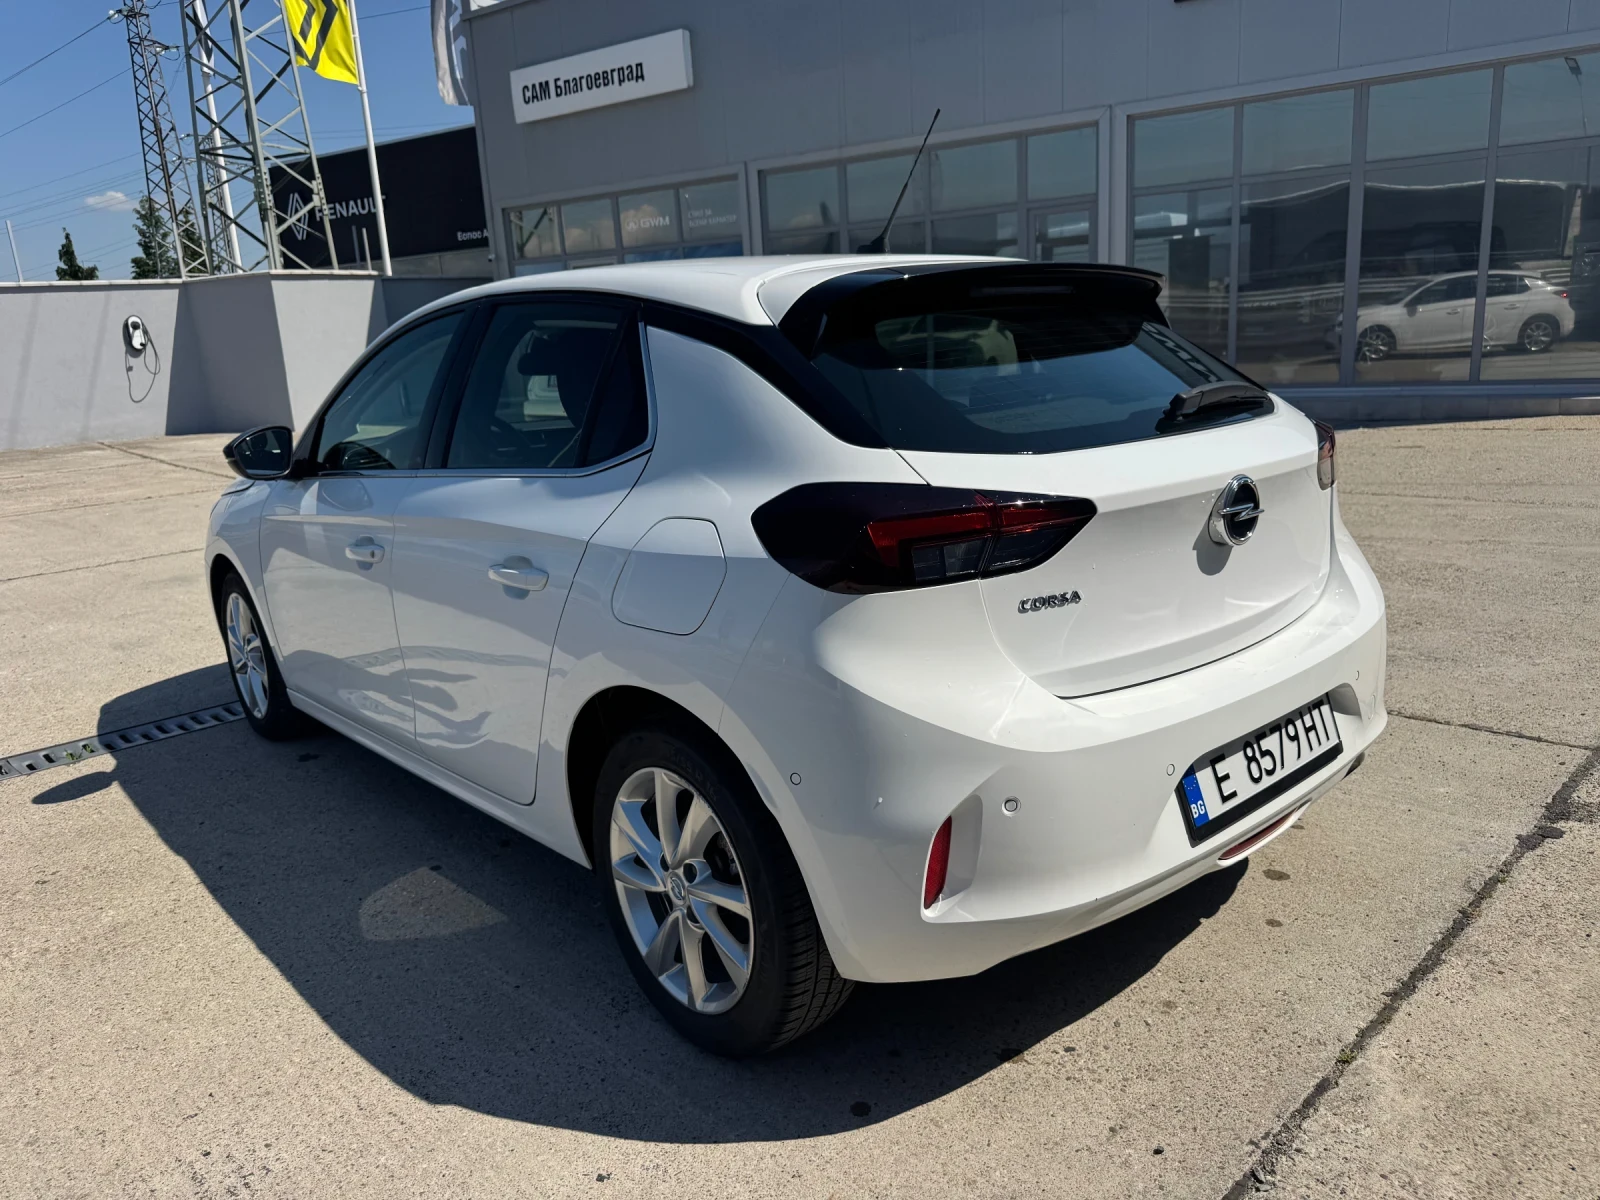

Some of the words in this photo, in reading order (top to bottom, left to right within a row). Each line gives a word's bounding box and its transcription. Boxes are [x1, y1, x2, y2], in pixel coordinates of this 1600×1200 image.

[522, 80, 551, 105] САМ
[555, 62, 645, 98] Благоевград
[640, 215, 670, 228] GWM
[1018, 590, 1082, 613] CORSA
[1209, 753, 1238, 805] E
[1190, 800, 1206, 819] BG
